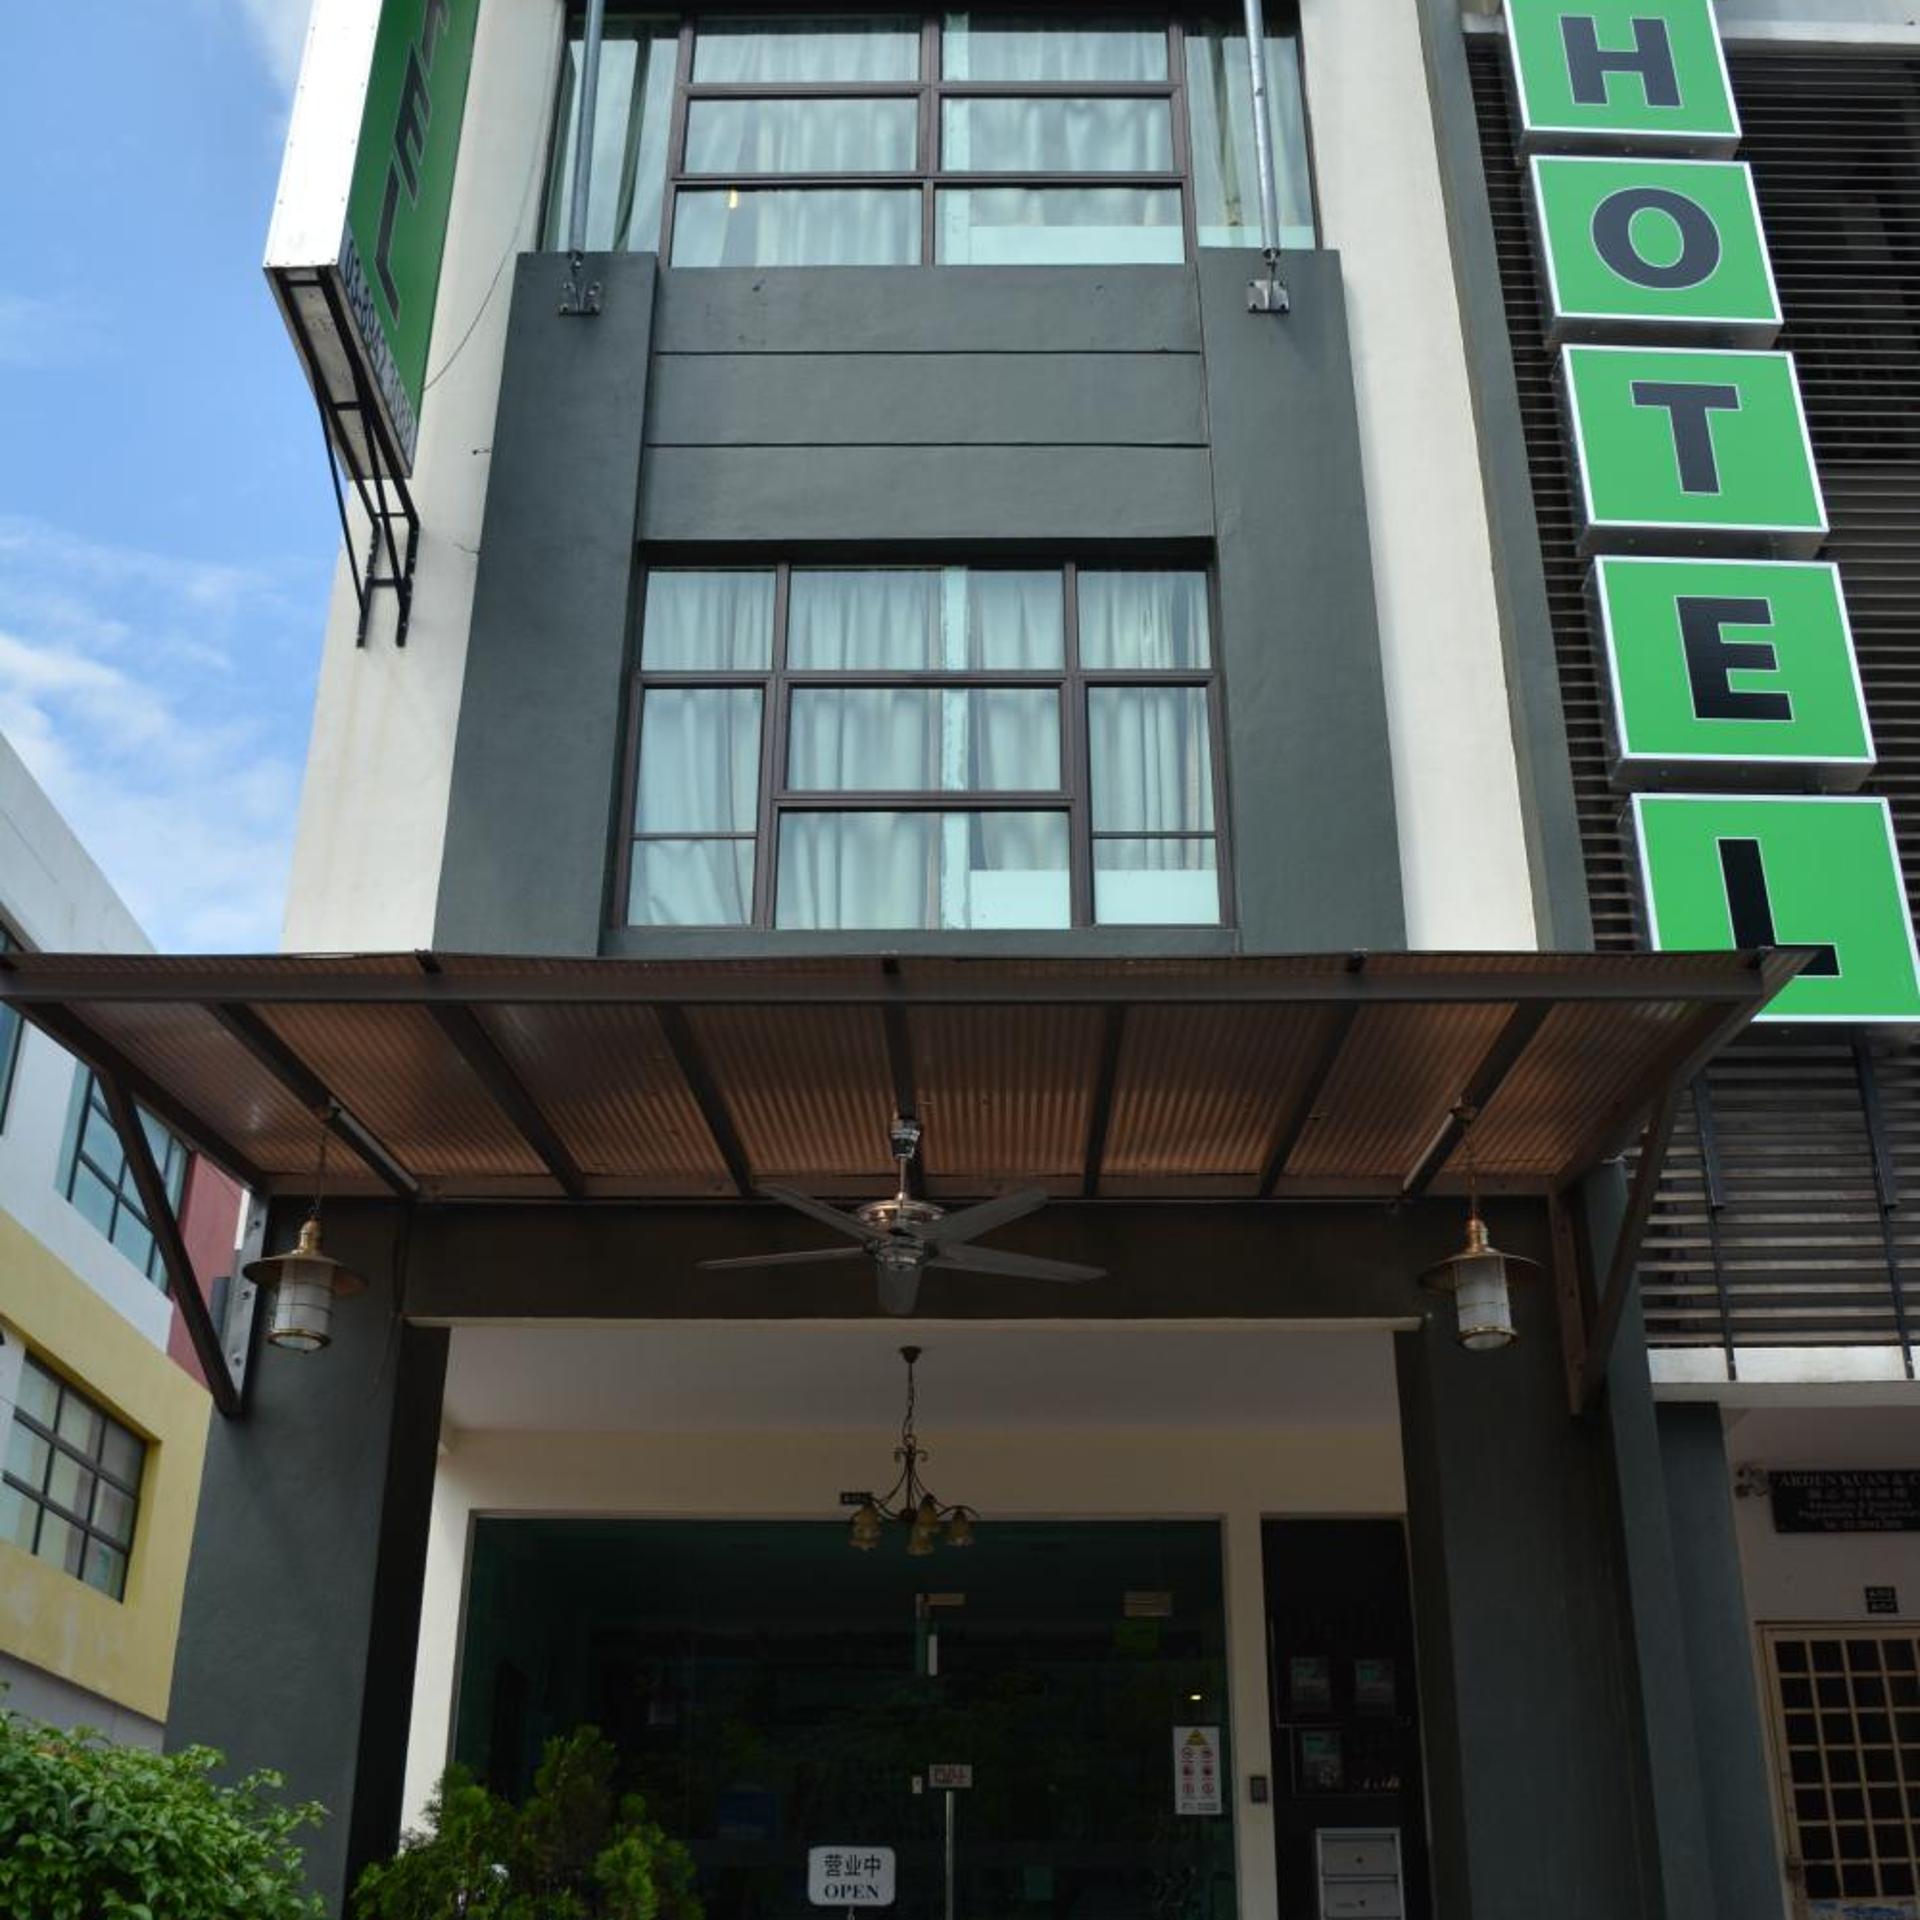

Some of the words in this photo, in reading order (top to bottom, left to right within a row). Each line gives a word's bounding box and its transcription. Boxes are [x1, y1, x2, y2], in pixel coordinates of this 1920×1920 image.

[1558, 14, 1842, 978] HOTEL
[824, 1854, 881, 1878] 营业中
[824, 1884, 879, 1899] OPEN
